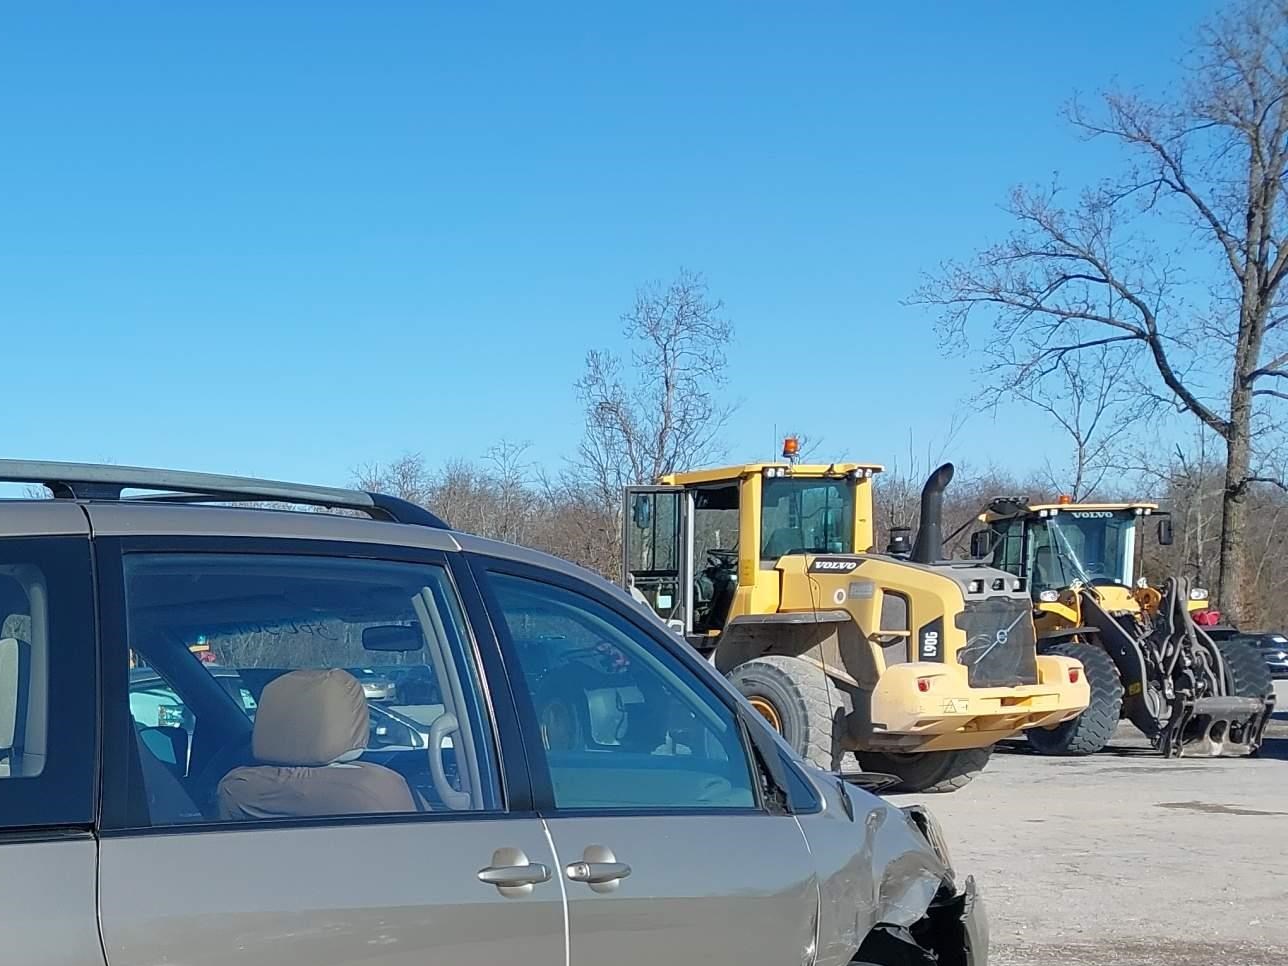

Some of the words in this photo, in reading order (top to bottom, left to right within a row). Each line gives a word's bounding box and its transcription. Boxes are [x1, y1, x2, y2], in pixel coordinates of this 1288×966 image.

[1072, 511, 1114, 519] VOLVO
[815, 561, 857, 570] VOLVO
[923, 631, 938, 657] L90G
